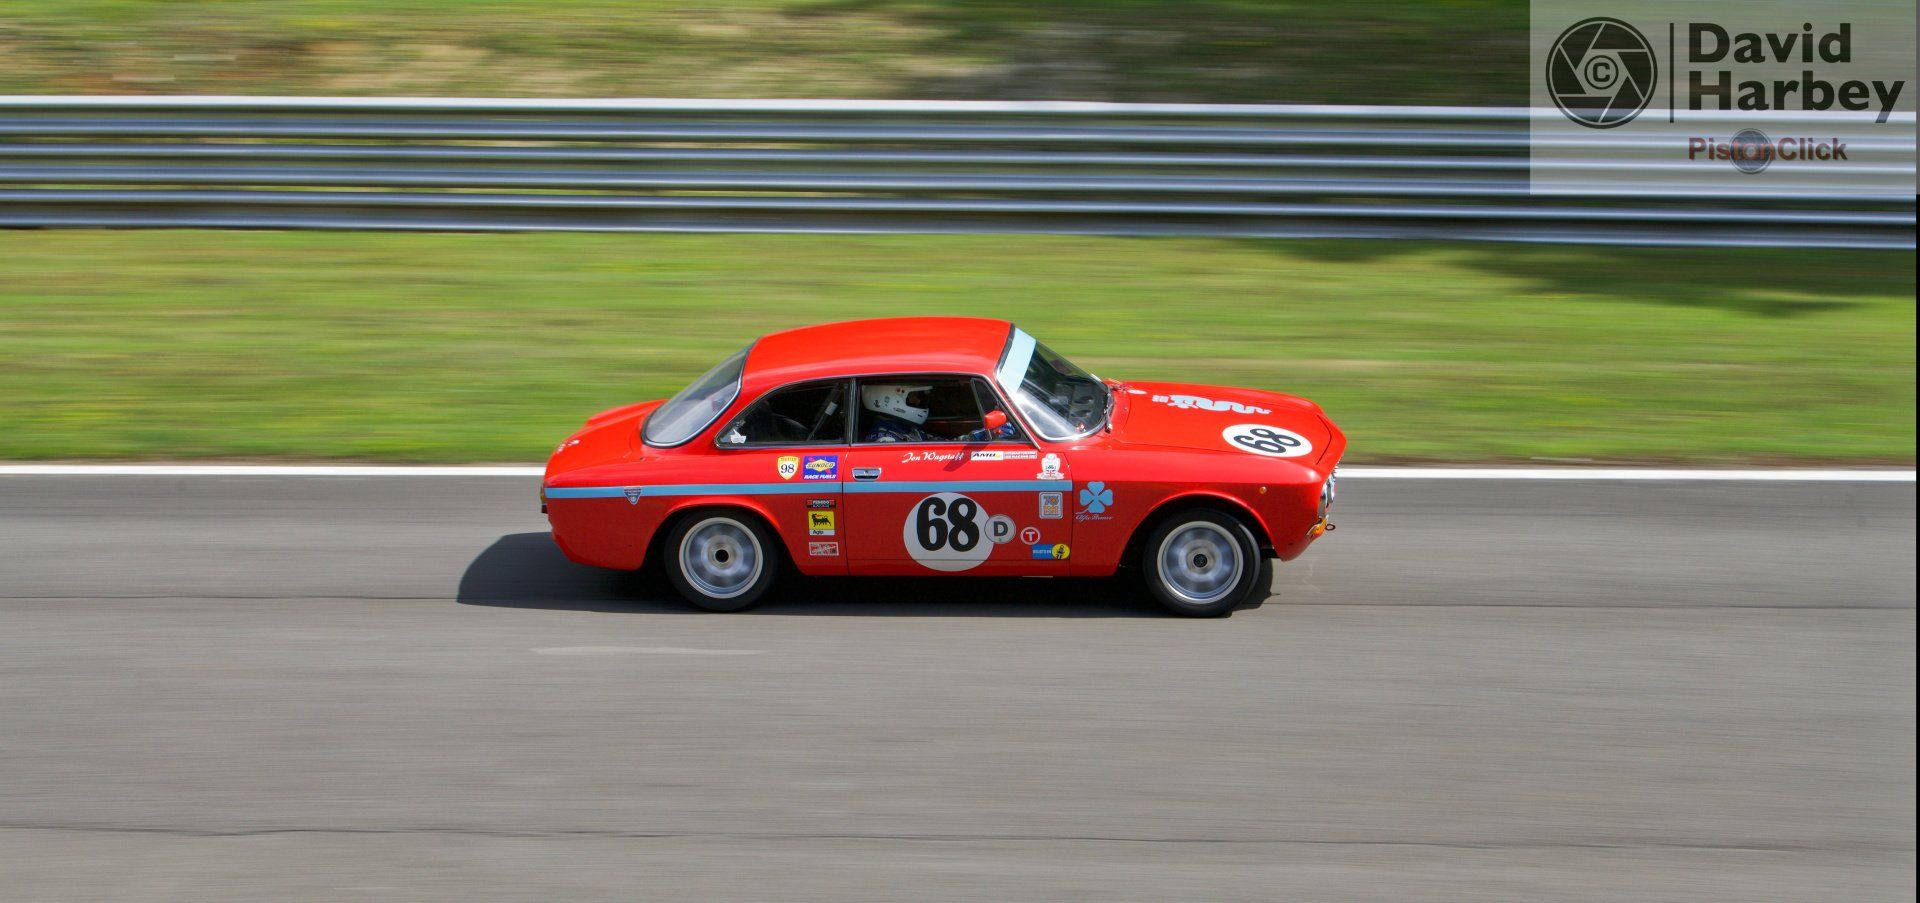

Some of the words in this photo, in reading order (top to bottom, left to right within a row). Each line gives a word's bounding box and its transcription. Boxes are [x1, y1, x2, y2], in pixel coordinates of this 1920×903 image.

[1233, 428, 1302, 454] 68
[780, 463, 795, 474] 98
[916, 496, 980, 553] 68
[993, 520, 1009, 536] D
[1025, 531, 1036, 542] T
